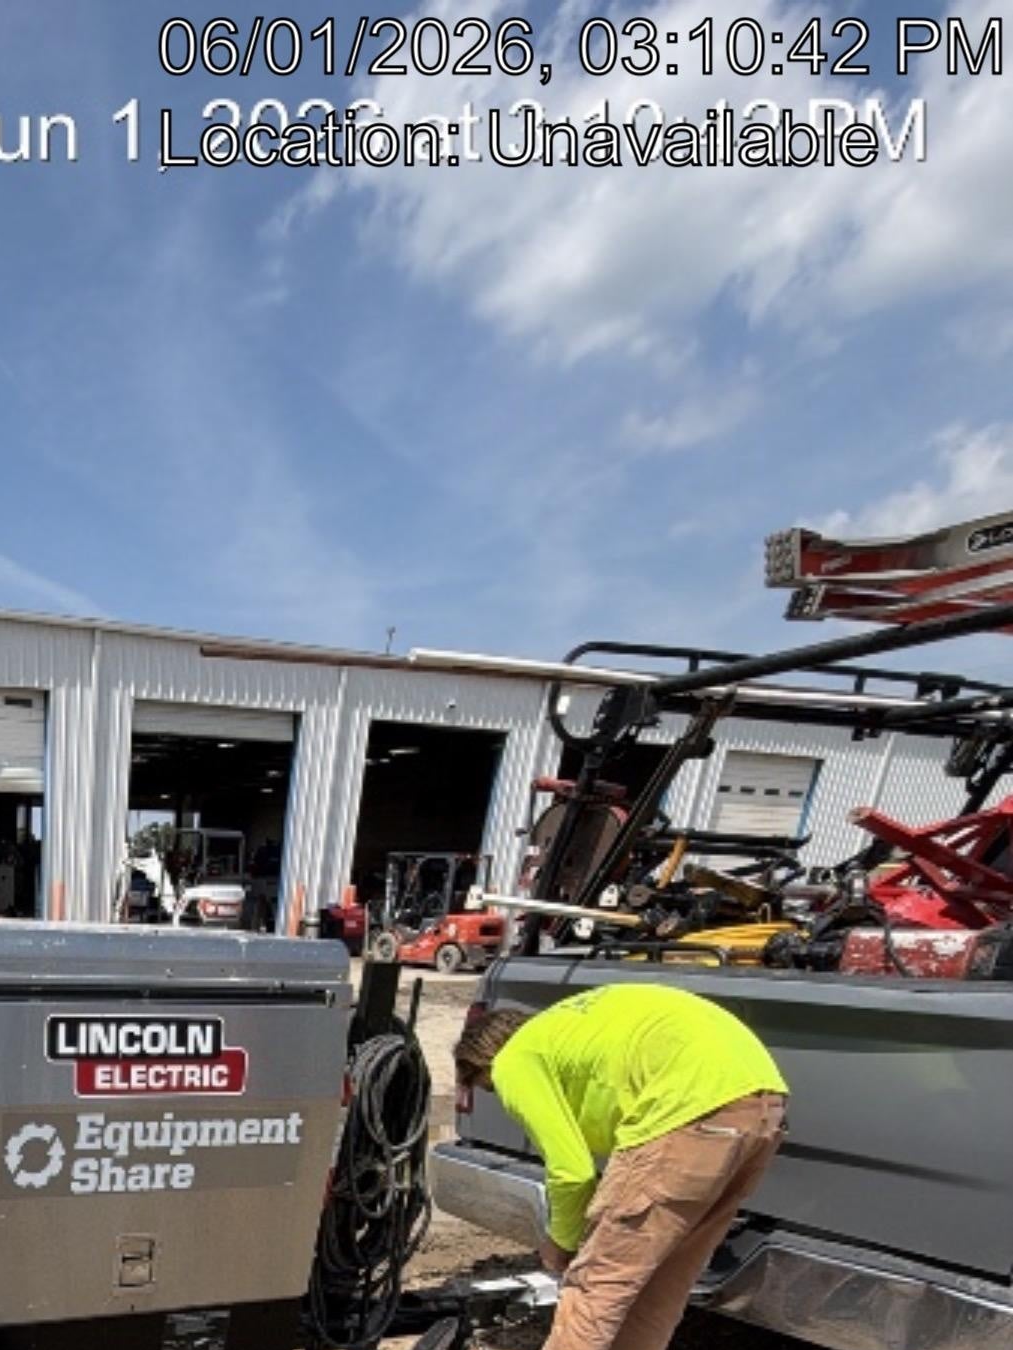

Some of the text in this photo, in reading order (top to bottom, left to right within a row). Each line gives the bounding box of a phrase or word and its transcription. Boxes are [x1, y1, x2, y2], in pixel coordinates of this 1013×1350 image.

[57, 1022, 214, 1055] LINCOLN
[94, 1064, 230, 1090] ELECTRIC
[74, 1112, 304, 1157] Equipment
[71, 1157, 195, 1194] Share
